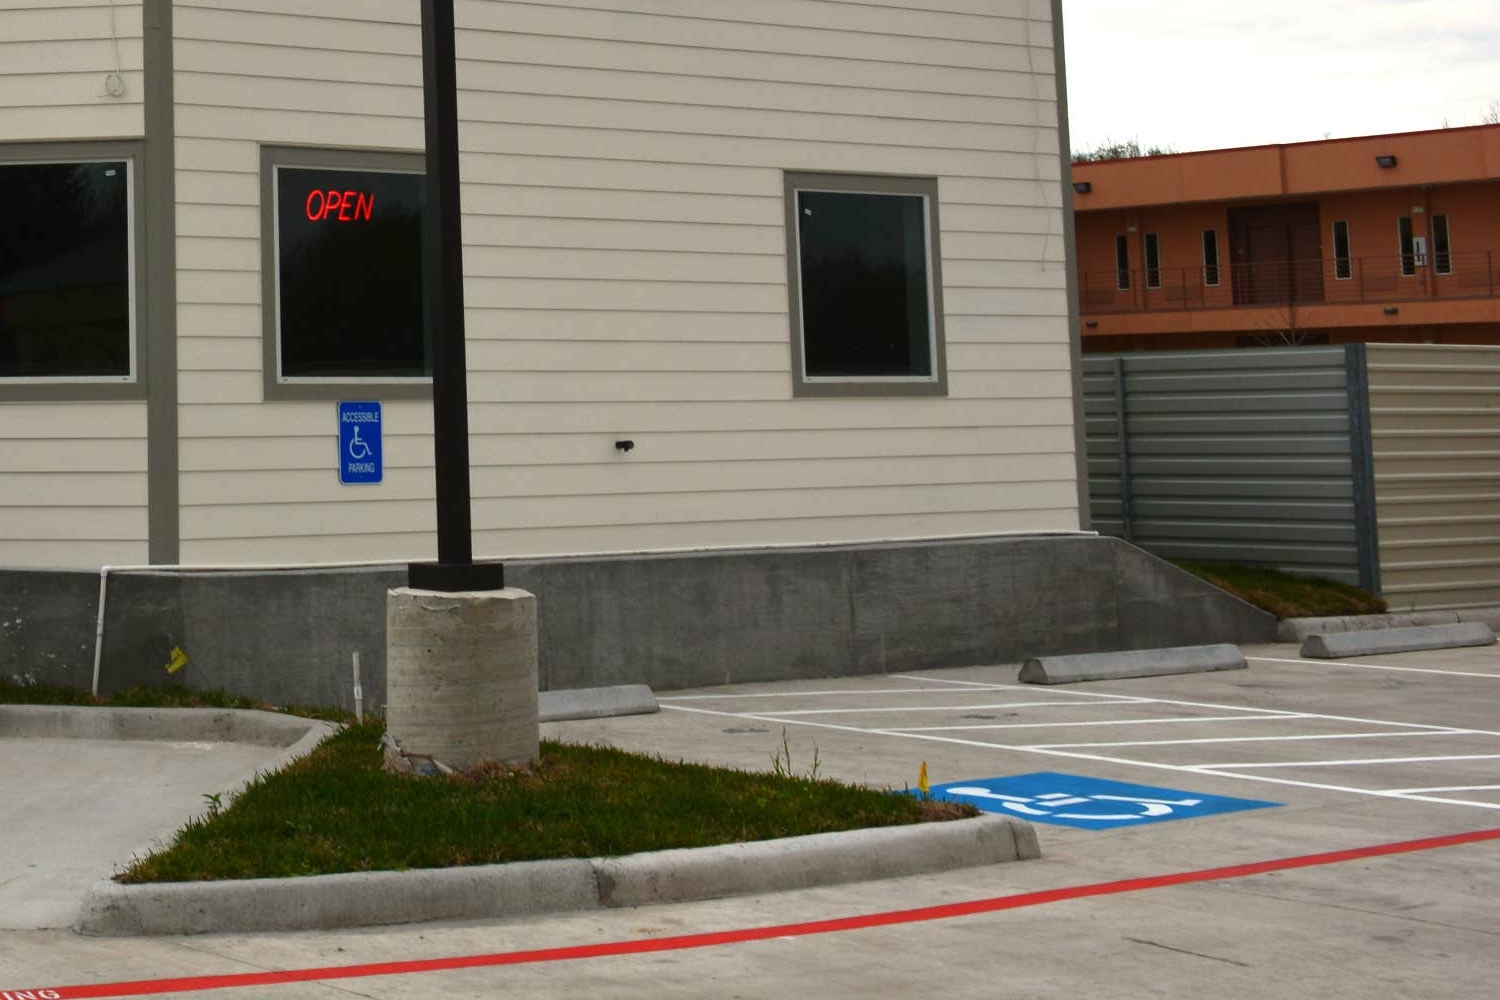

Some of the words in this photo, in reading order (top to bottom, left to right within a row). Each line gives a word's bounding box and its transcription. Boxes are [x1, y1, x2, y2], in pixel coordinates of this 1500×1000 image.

[305, 189, 375, 221] OPEN
[342, 411, 380, 423] ACCESSIBLE
[348, 462, 375, 473] PARKING
